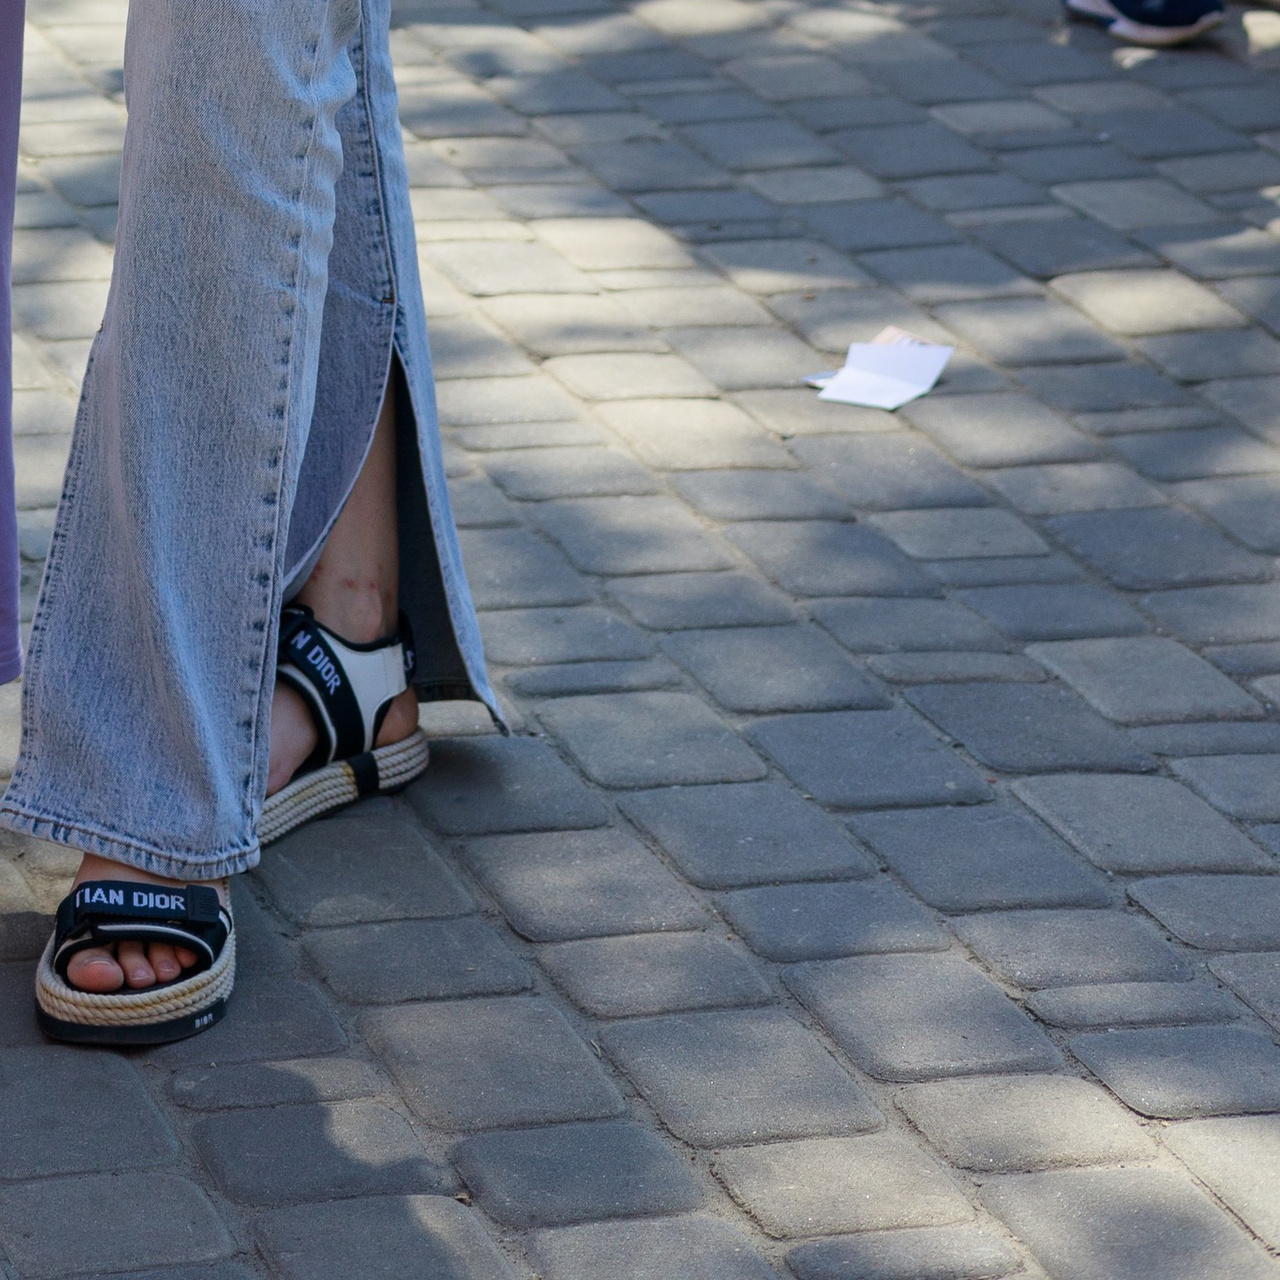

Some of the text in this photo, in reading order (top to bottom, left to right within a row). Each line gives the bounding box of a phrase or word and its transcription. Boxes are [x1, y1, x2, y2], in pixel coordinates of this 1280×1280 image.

[306, 644, 342, 696] DIOR
[132, 890, 187, 911] DIOR
[194, 1012, 214, 1030] DIOR
